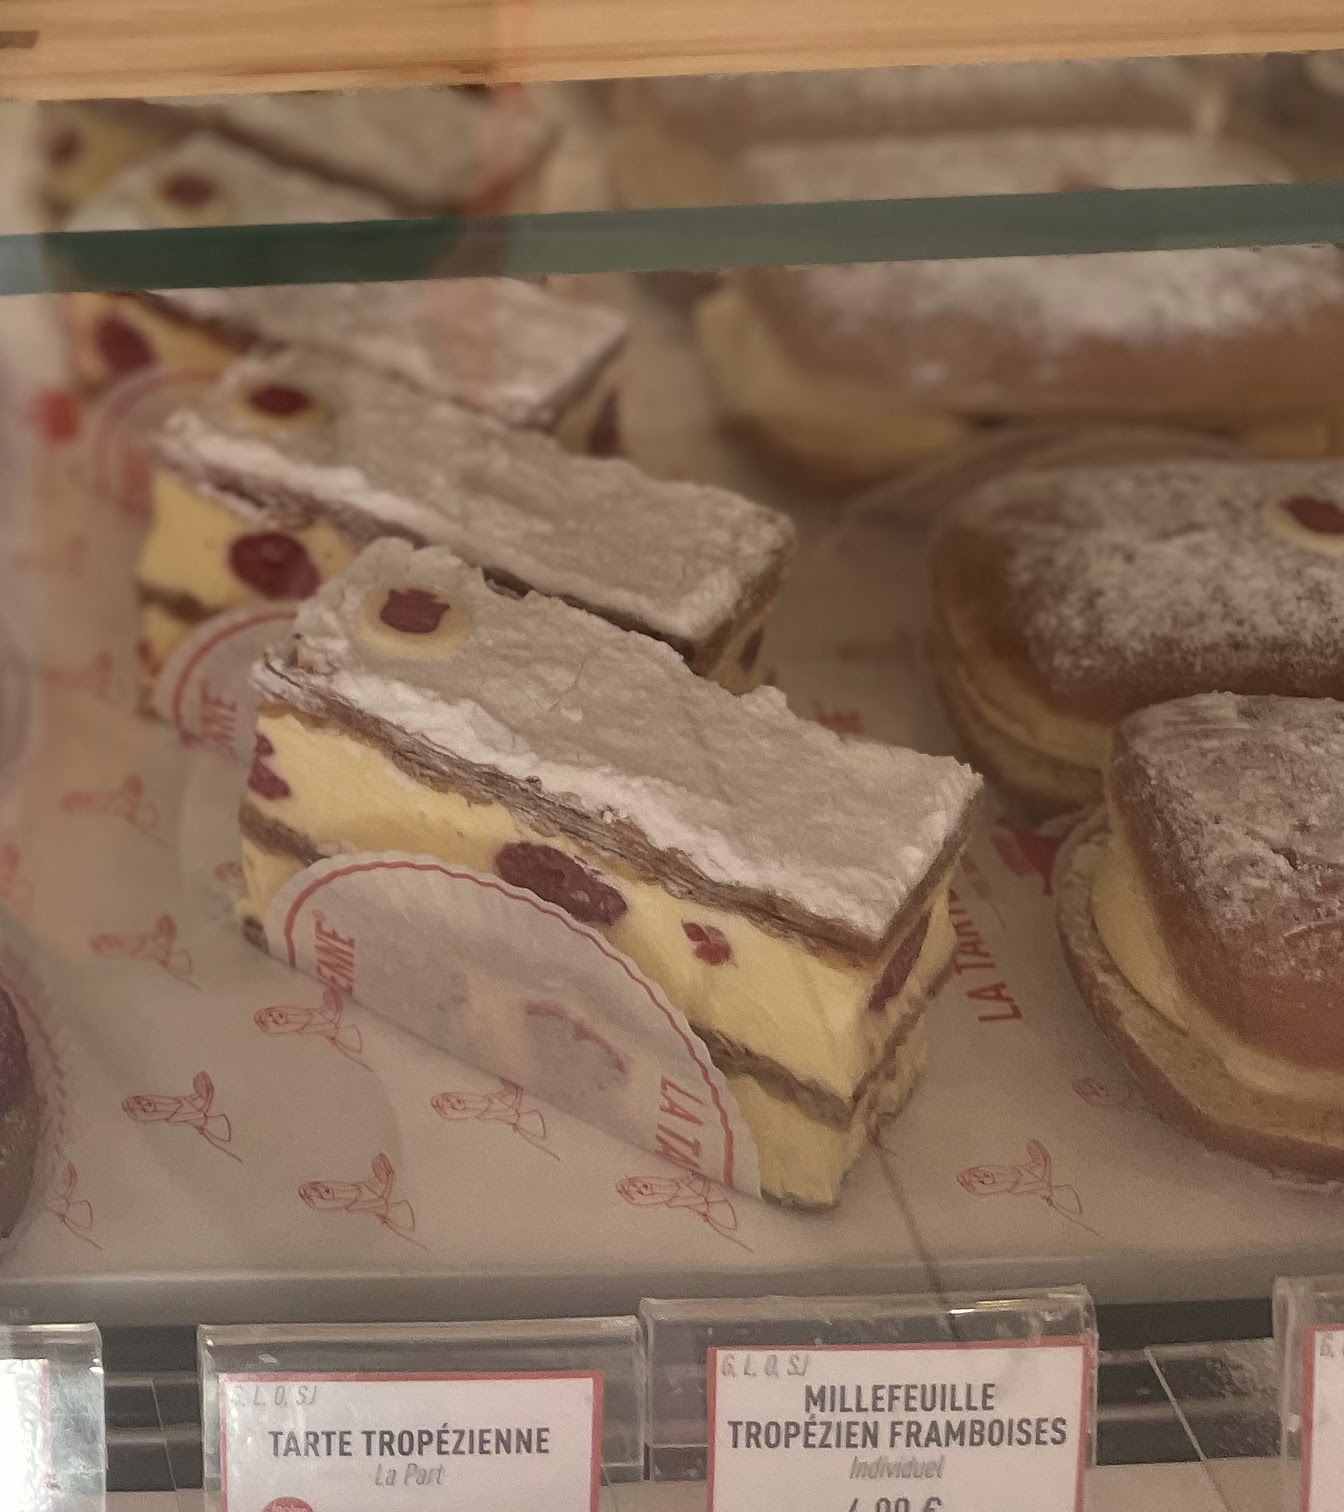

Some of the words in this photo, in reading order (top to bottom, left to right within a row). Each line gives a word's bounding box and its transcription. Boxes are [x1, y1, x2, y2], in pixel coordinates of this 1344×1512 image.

[804, 1382, 996, 1413] MILLEFEUILLE
[268, 1429, 353, 1457] TARTE
[360, 1422, 551, 1457] TROPÉZIENNE
[728, 1414, 879, 1449] TROPÉZIEN
[889, 1416, 1068, 1448] FRAMBOISES
[374, 1462, 397, 1487] La
[404, 1463, 445, 1487] Part
[849, 1455, 945, 1480] Individuel
